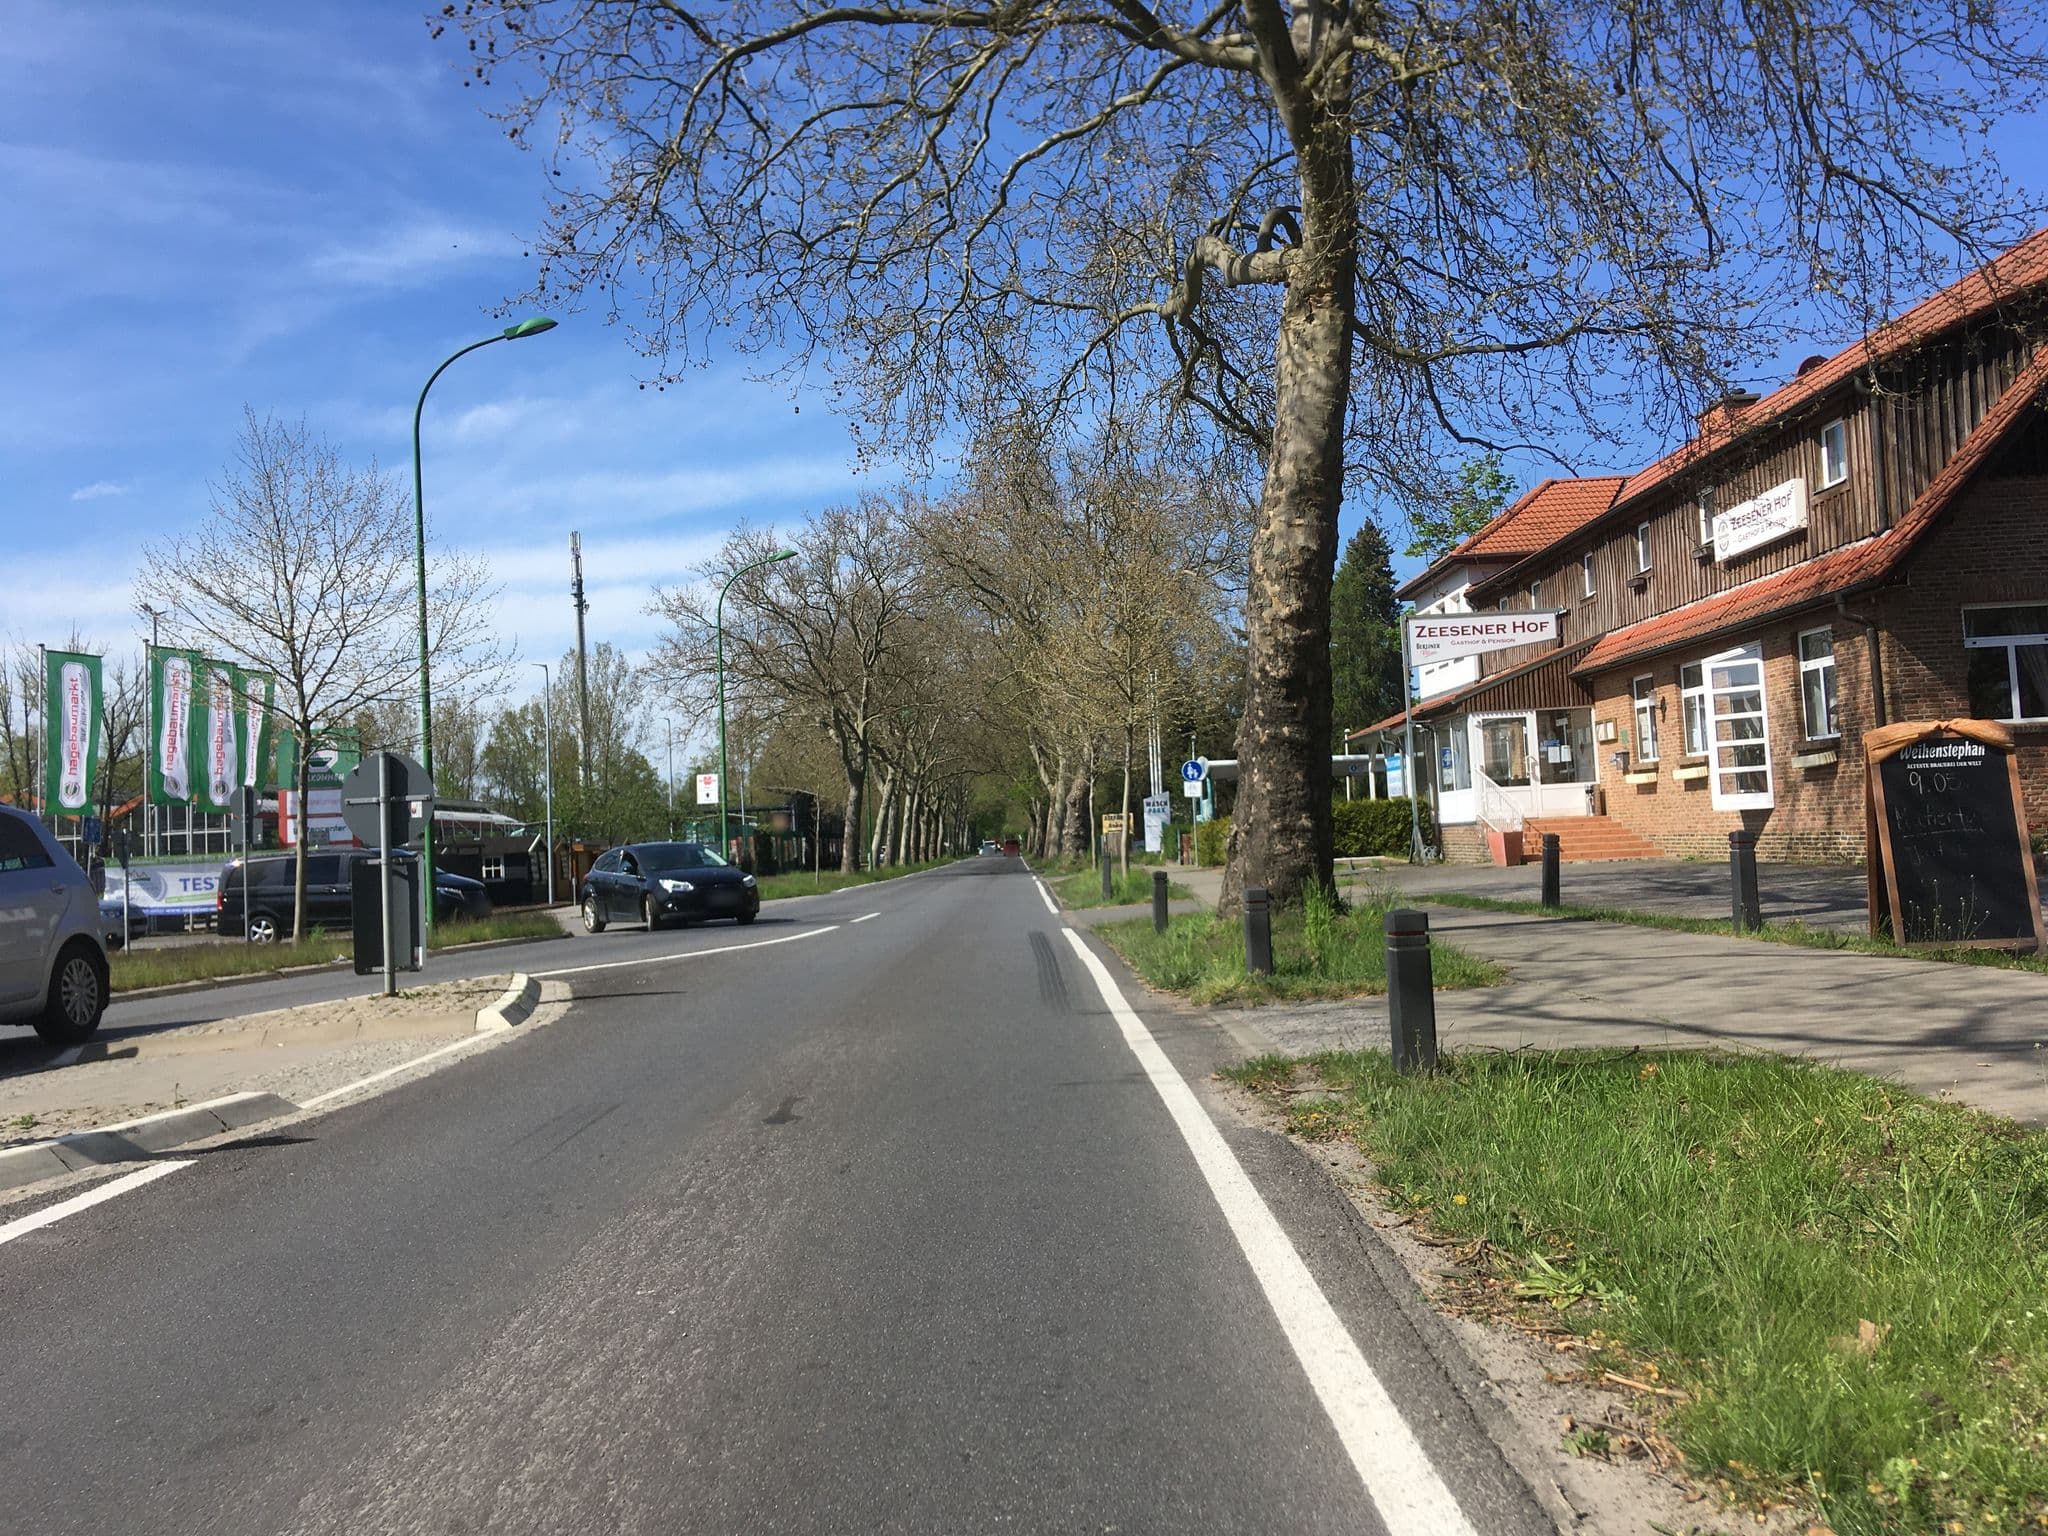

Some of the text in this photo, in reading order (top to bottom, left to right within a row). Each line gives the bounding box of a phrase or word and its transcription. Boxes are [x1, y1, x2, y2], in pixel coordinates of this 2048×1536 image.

[1730, 492, 1791, 530] ZEESENER HOF
[1415, 621, 1549, 638] ZEESENER HOF
[68, 677, 80, 776] hagebaumarkt
[1900, 741, 1985, 760] Weihenstephan
